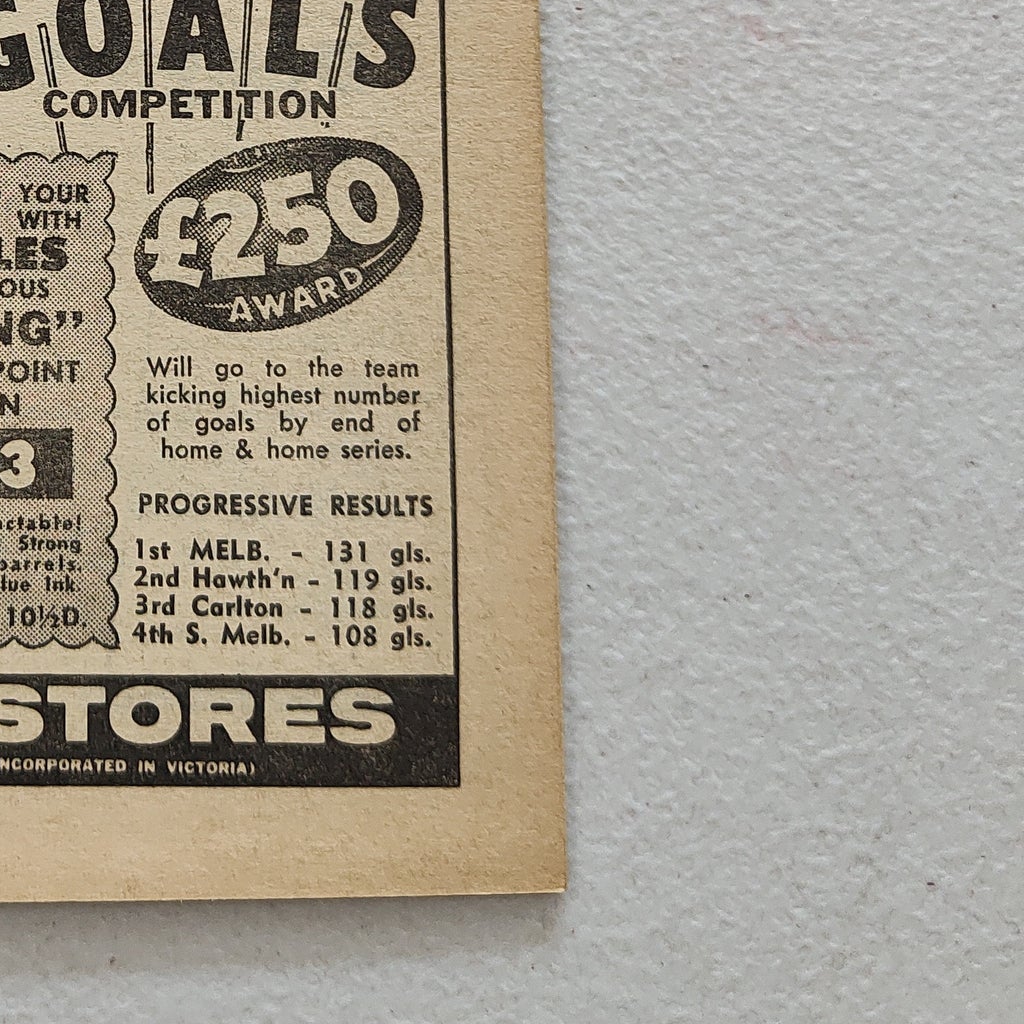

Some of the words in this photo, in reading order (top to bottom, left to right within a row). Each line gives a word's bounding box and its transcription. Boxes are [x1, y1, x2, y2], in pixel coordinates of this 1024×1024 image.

[43, 89, 338, 120] COMPETITION
[19, 184, 89, 203] YOUR
[17, 210, 82, 230] WITH
[144, 156, 400, 288] £250
[229, 268, 363, 322] AWARD
[147, 356, 192, 377] Will
[215, 361, 243, 381] go
[265, 359, 287, 377] to
[308, 356, 343, 377] the
[365, 359, 419, 377] team
[146, 383, 226, 408] kicking
[241, 383, 321, 408] highest
[334, 384, 420, 404] number
[147, 410, 171, 432] of
[195, 411, 255, 434] goals
[279, 411, 308, 434] by
[331, 411, 374, 432] end
[397, 411, 420, 432] of
[161, 439, 223, 459] home
[236, 439, 253, 459] &
[267, 439, 330, 459] home
[341, 440, 411, 459] series.
[139, 493, 313, 515] PROGRESSIVE
[331, 495, 433, 517] RESULTS
[19, 535, 81, 553] Strong
[136, 539, 171, 559] 1st
[190, 539, 270, 561] MELB.
[325, 541, 367, 562] 131
[391, 541, 431, 566] gls.
[134, 567, 180, 587] 2nd
[192, 567, 295, 589] Hawth'n
[334, 569, 379, 590] 119
[391, 570, 432, 594] gls.
[135, 595, 175, 616] 3rd
[192, 595, 283, 617] Carlton
[331, 596, 376, 618] 118
[392, 597, 434, 622] gls.
[132, 622, 173, 644] 4th
[186, 623, 207, 645] S.
[222, 623, 290, 646] Melb.
[332, 624, 377, 646] 108
[391, 625, 432, 650] gls.
[138, 760, 156, 773] IN
[167, 760, 255, 775] VICTORIA)
